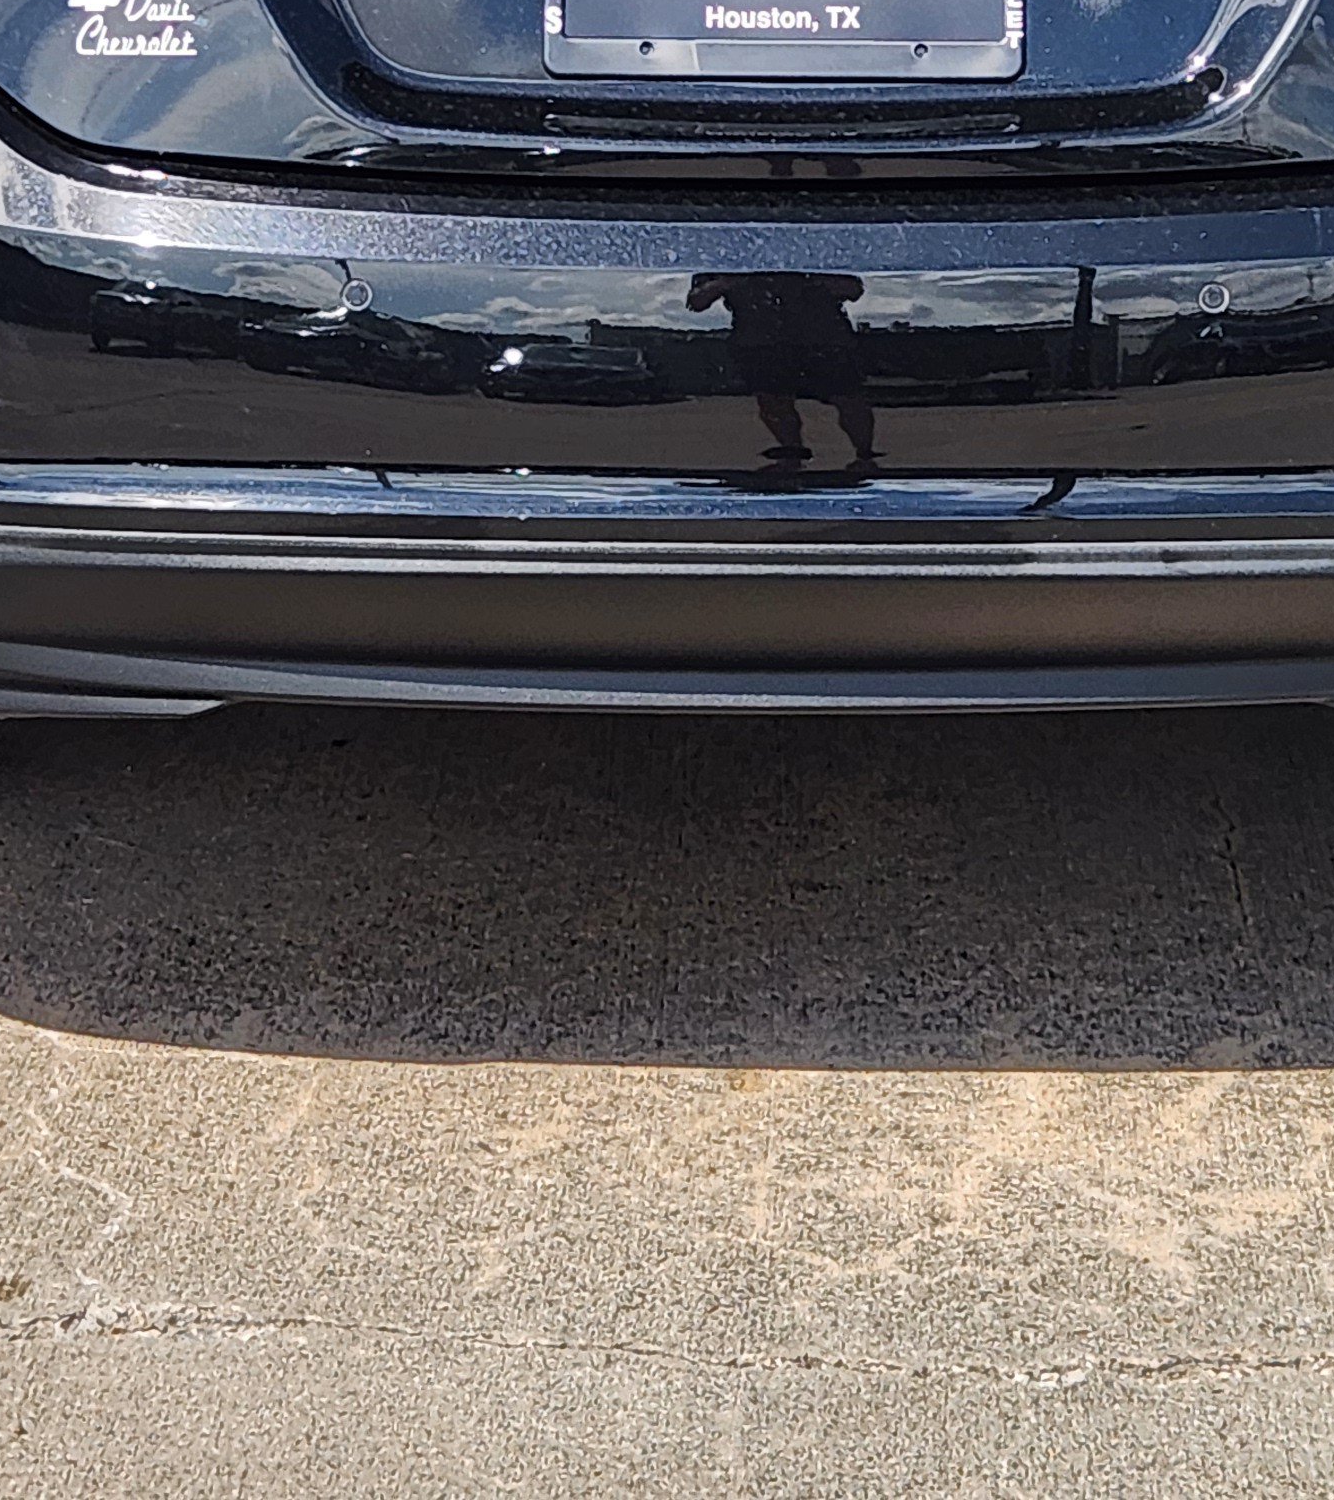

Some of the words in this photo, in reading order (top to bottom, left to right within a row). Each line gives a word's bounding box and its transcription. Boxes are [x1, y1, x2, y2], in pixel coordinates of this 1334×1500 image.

[75, 14, 198, 56] Chevrolet
[705, 5, 819, 32] Houston,
[825, 5, 861, 29] TX
